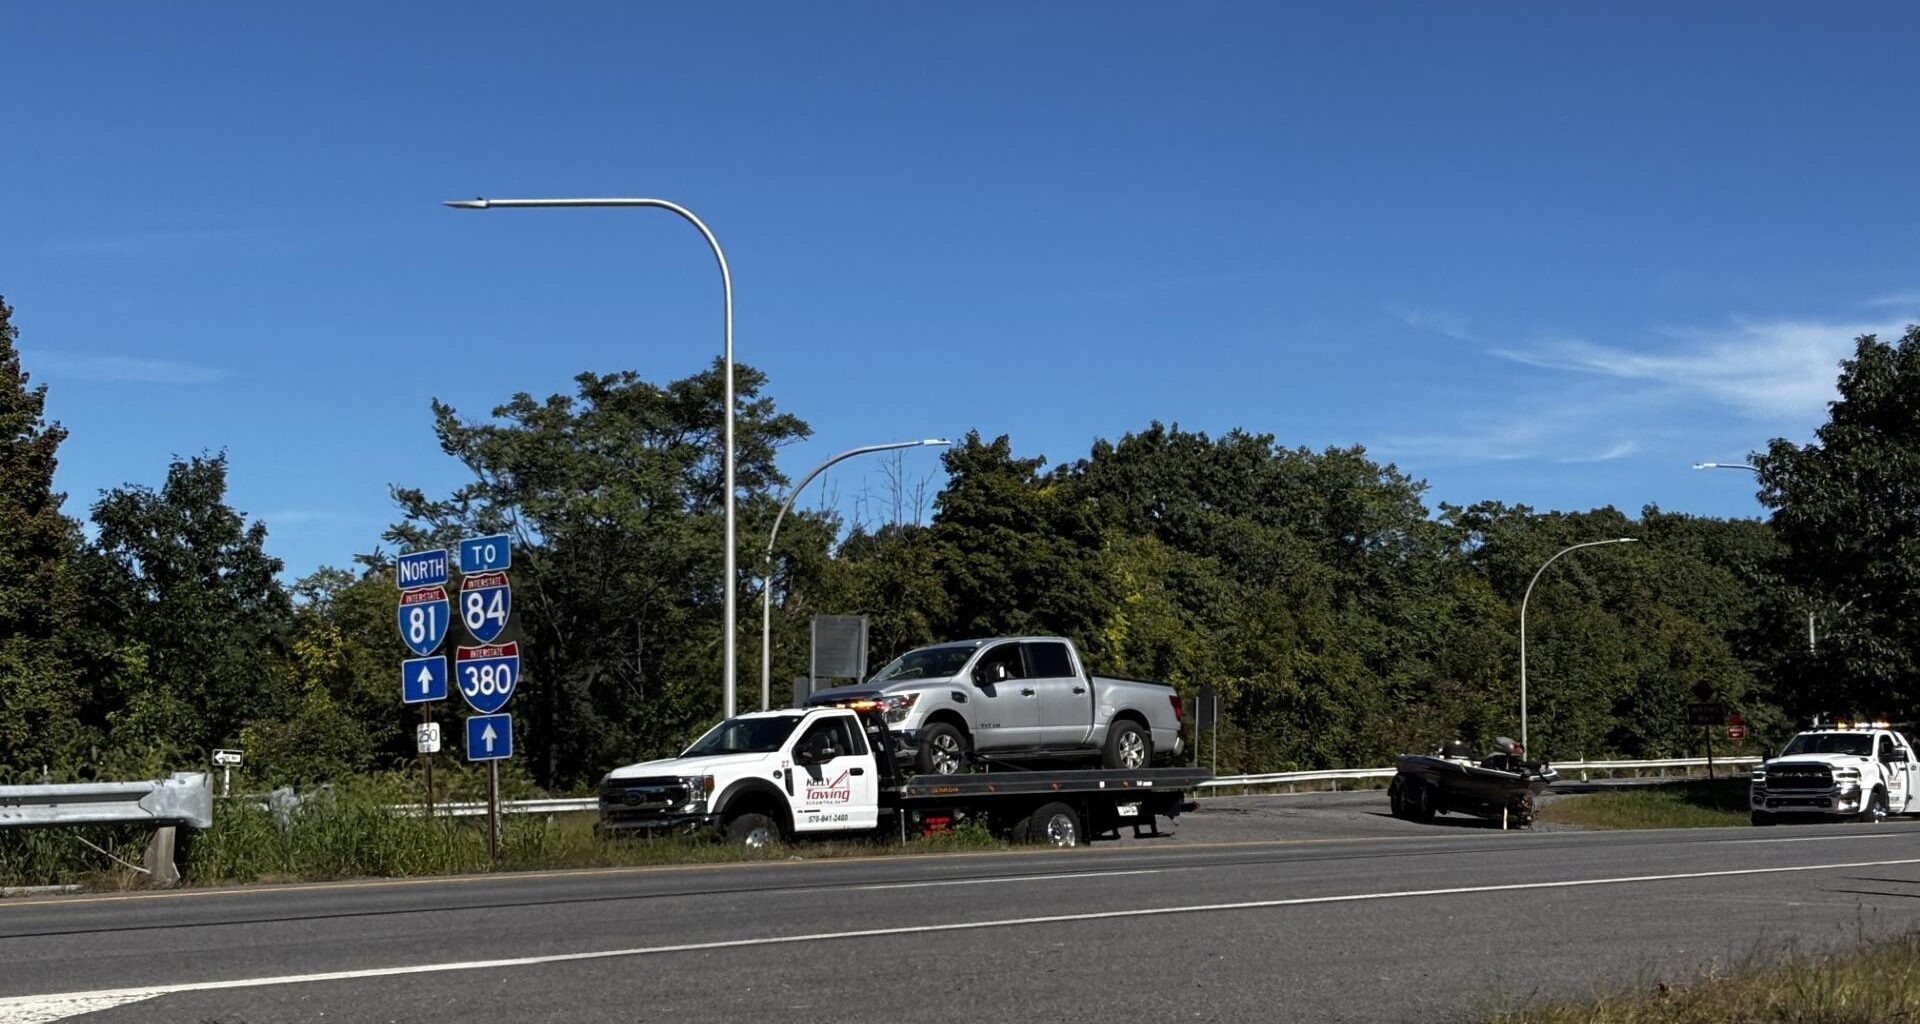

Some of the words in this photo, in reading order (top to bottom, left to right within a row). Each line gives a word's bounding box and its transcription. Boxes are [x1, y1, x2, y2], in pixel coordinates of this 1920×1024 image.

[472, 544, 496, 564] TO
[400, 558, 445, 583] NORTH
[468, 576, 502, 588] INTERSTATE
[406, 590, 441, 603] INTERSTATE
[467, 590, 506, 630] 84
[409, 605, 436, 644] 81
[470, 648, 504, 658] INTERSTATE
[465, 663, 511, 697] 380
[418, 729, 437, 743] 250
[806, 789, 850, 802] Towing
